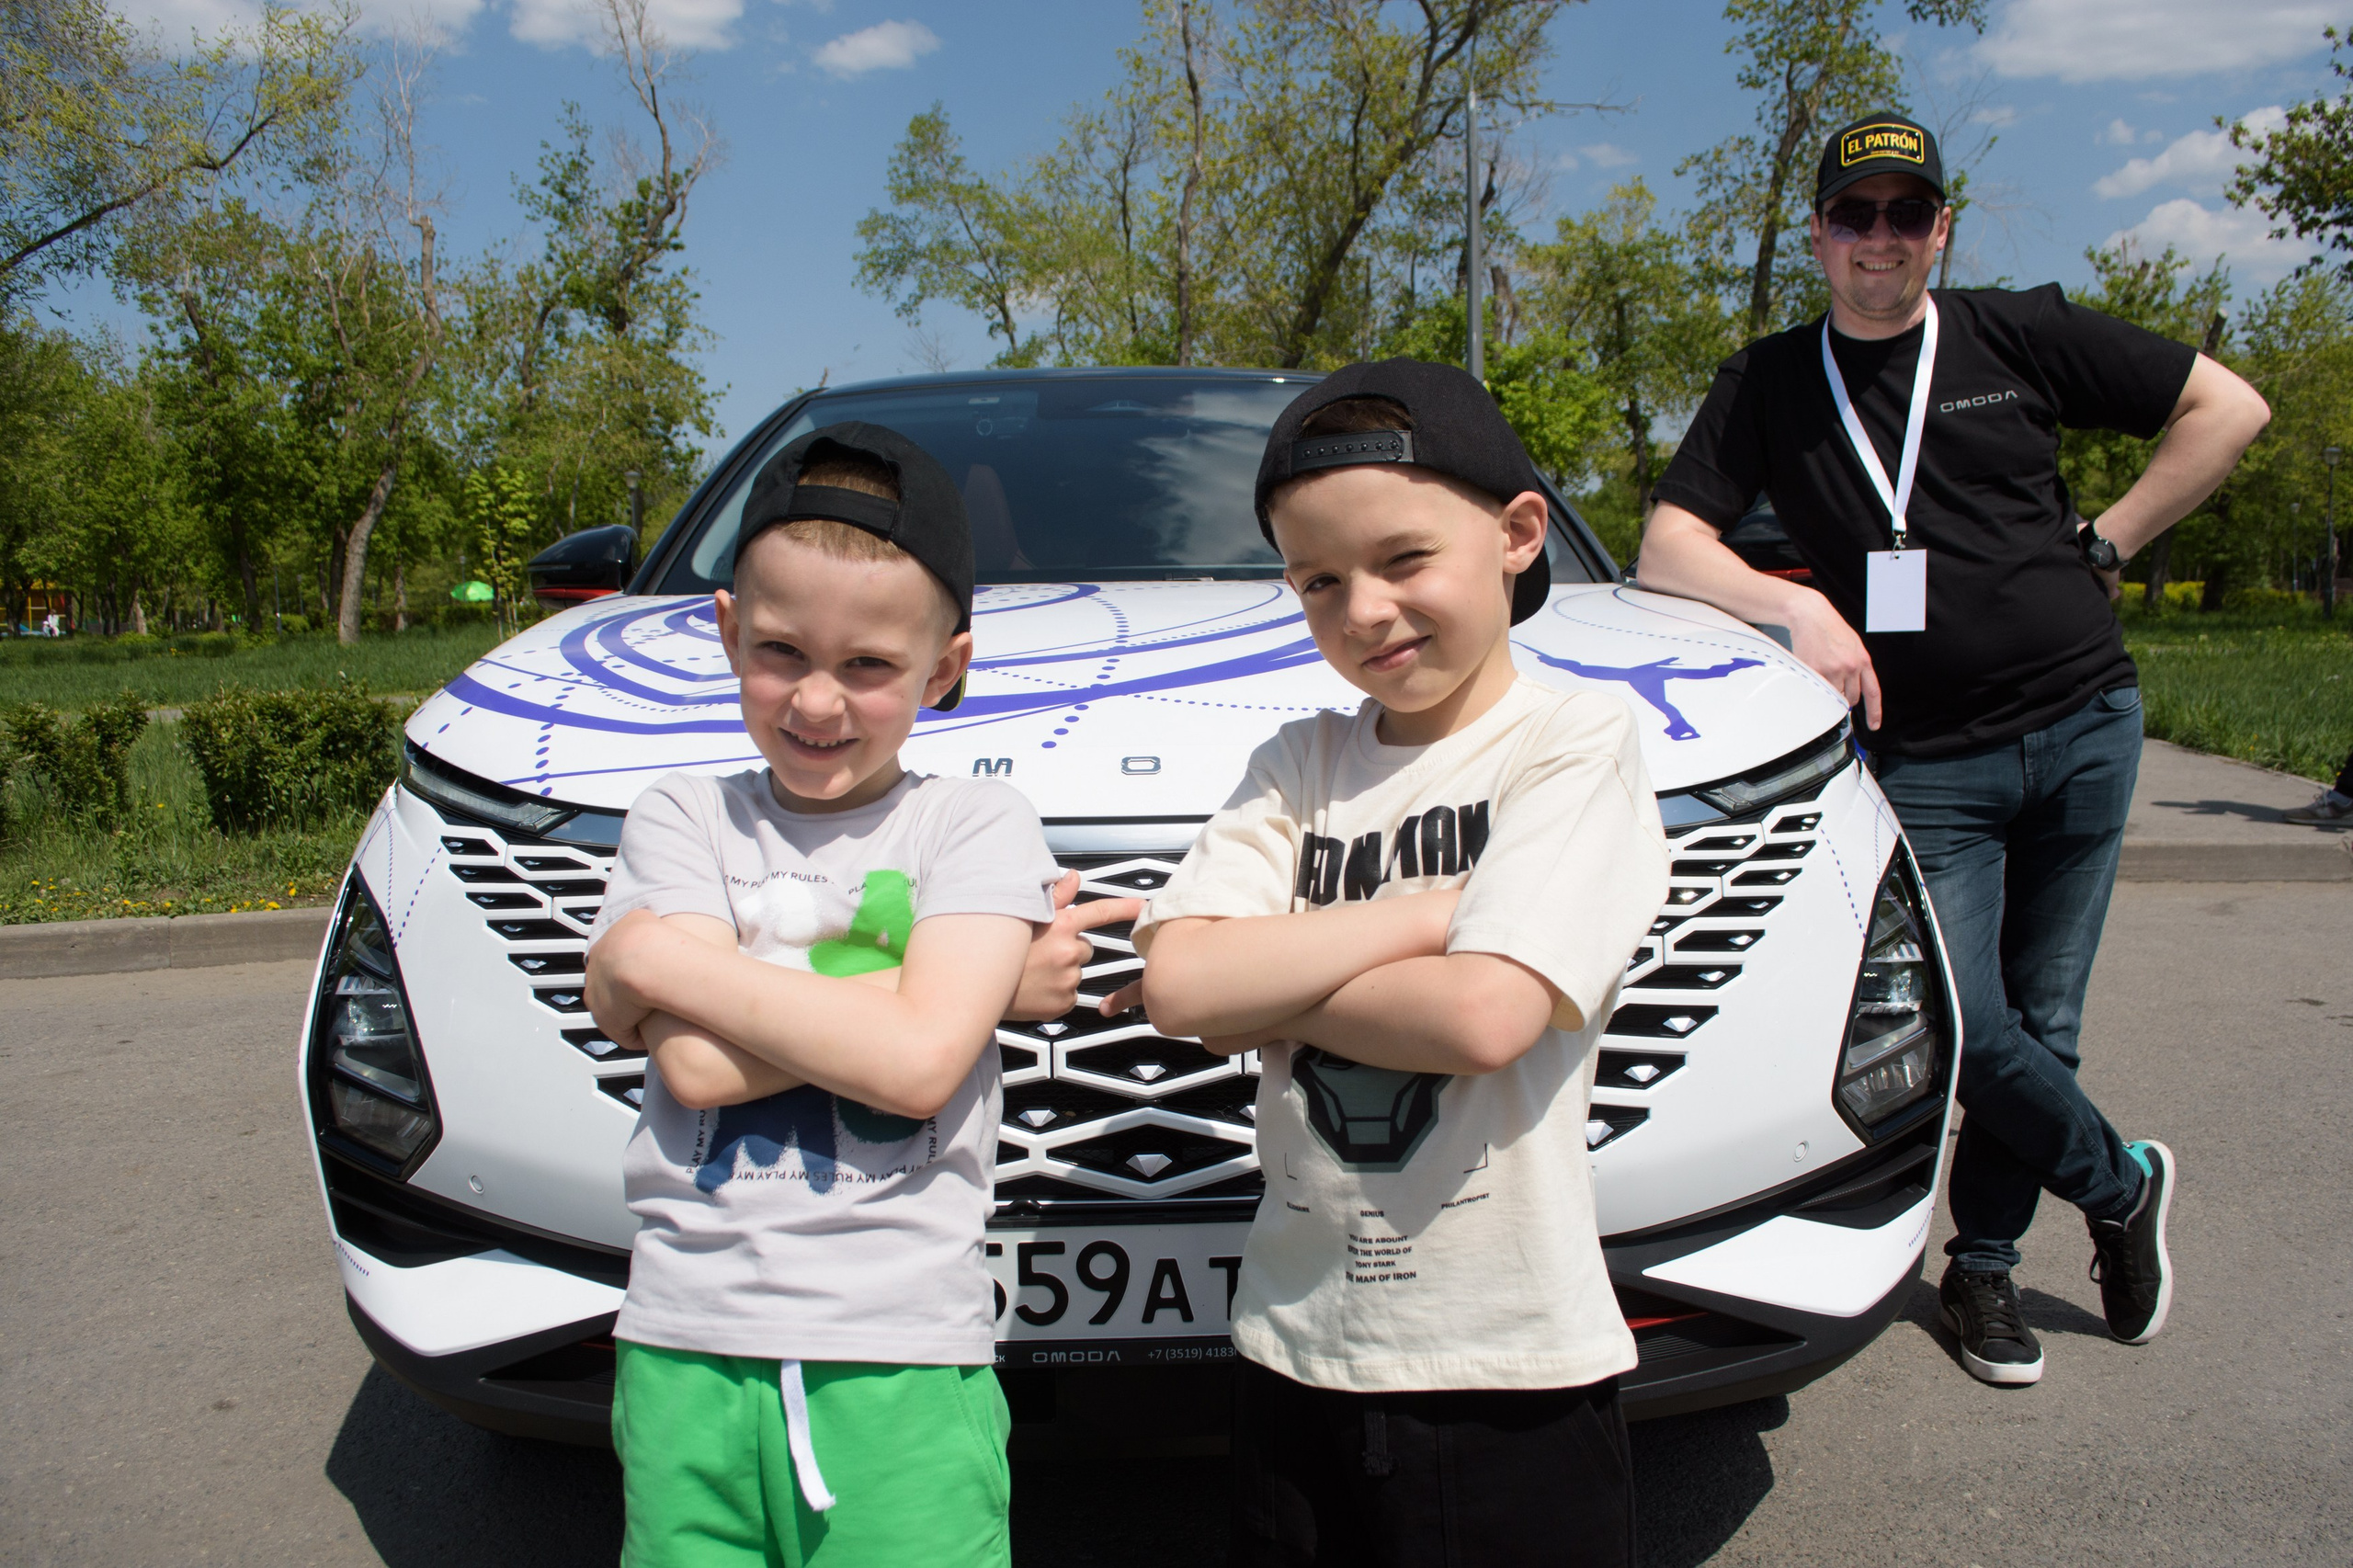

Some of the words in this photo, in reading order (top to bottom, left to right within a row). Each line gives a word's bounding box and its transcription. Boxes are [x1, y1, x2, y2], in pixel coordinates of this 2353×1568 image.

[1847, 139, 1862, 154] EL
[1865, 132, 1917, 152] PATRÓN
[1939, 390, 2018, 413] OMODA
[730, 876, 748, 888] MY
[771, 871, 789, 881] MY
[790, 871, 828, 883] RULES
[847, 881, 869, 895] PLA
[696, 1130, 705, 1148] MY
[736, 1170, 755, 1181] MY
[756, 1170, 786, 1181] PLAY
[790, 1170, 810, 1181] MY
[813, 1172, 853, 1183] RULES
[857, 1173, 876, 1183] MY
[1374, 1247, 1402, 1256] WORLD
[1403, 1245, 1412, 1254] OF
[1355, 1260, 1371, 1268] TONY
[1373, 1259, 1396, 1268] STARK
[1356, 1274, 1376, 1284] MAN
[1379, 1273, 1391, 1282] OF
[1392, 1270, 1416, 1281] IRON
[1032, 1350, 1121, 1363] OMODA
[1148, 1348, 1162, 1359] +7
[1165, 1347, 1202, 1360] (3519)
[1206, 1346, 1237, 1358] 4183
